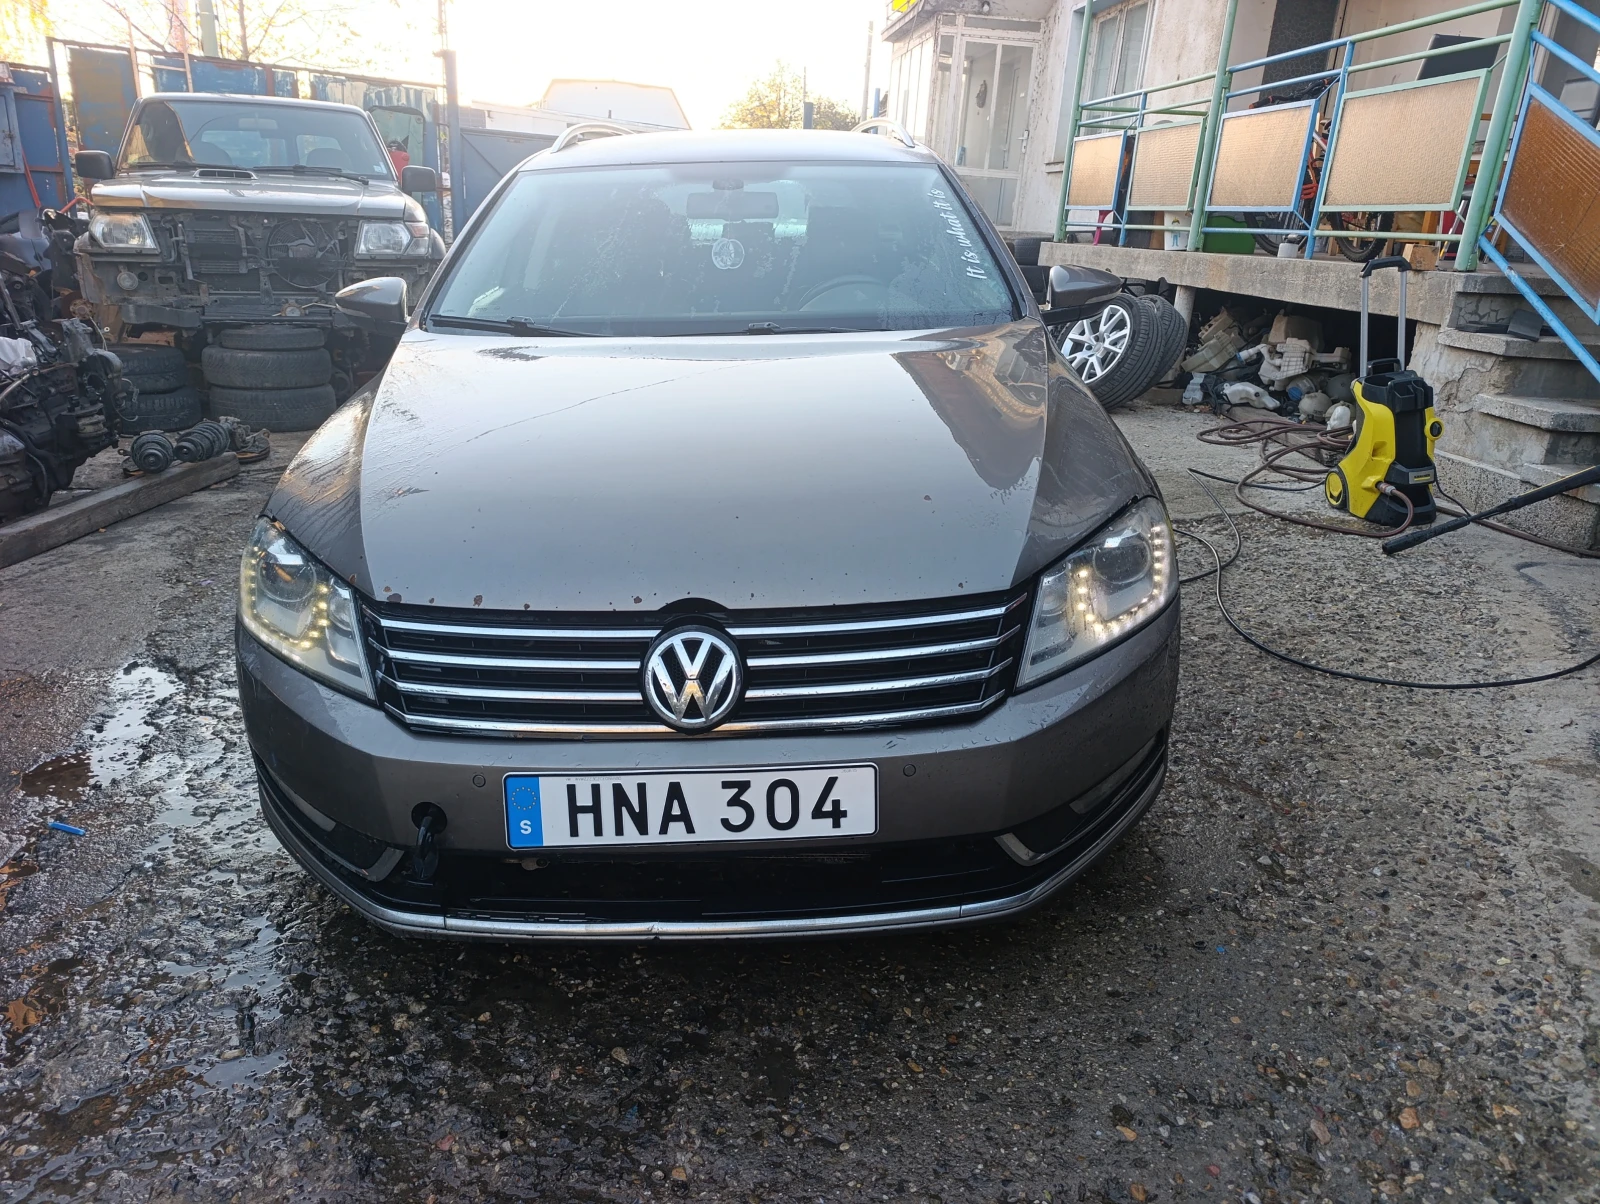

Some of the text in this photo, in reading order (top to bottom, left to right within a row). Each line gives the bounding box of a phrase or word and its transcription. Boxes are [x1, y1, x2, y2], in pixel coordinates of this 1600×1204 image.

[927, 188, 946, 199] is
[933, 199, 953, 210] it
[940, 211, 972, 247] what
[961, 249, 980, 264] is
[644, 625, 742, 728] VW
[520, 776, 847, 837] S HNA 304
